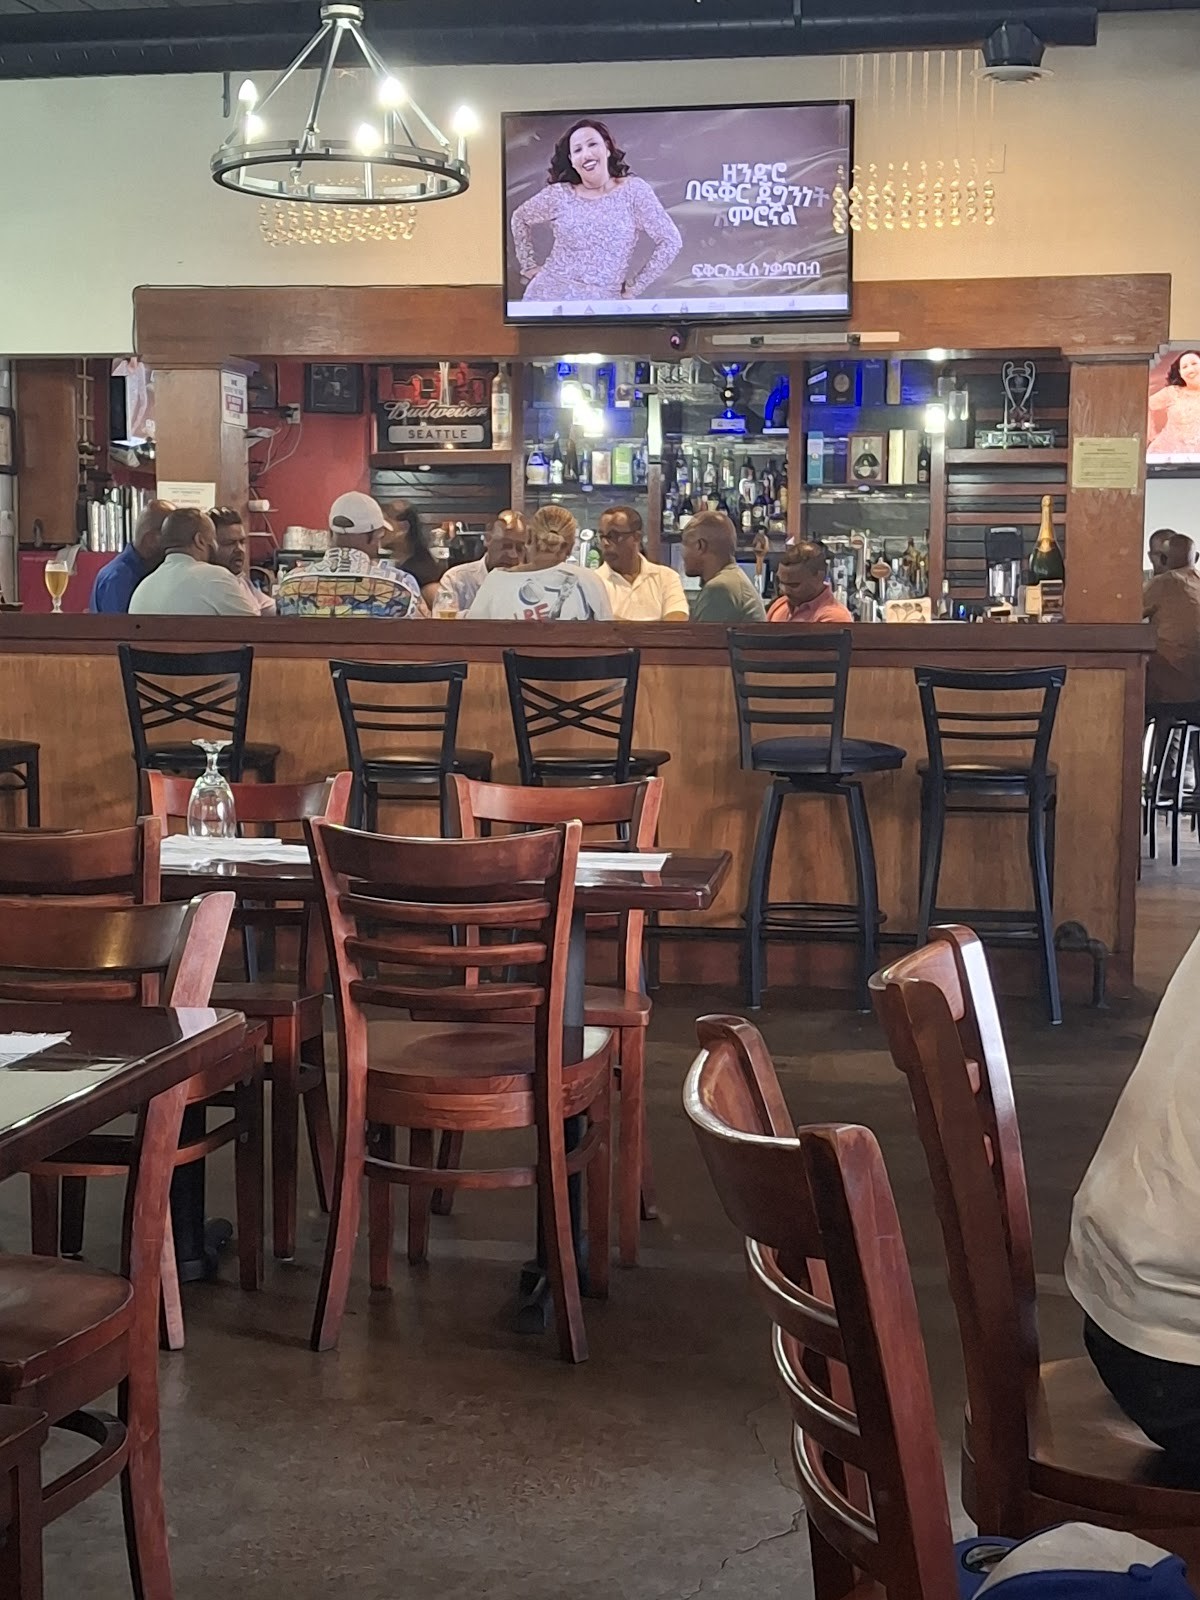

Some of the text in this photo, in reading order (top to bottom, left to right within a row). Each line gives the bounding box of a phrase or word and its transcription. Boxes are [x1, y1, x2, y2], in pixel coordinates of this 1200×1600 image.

[685, 180, 751, 204] በፍቅር
[384, 401, 488, 420] Budweiser
[408, 429, 467, 439] SEATTLE
